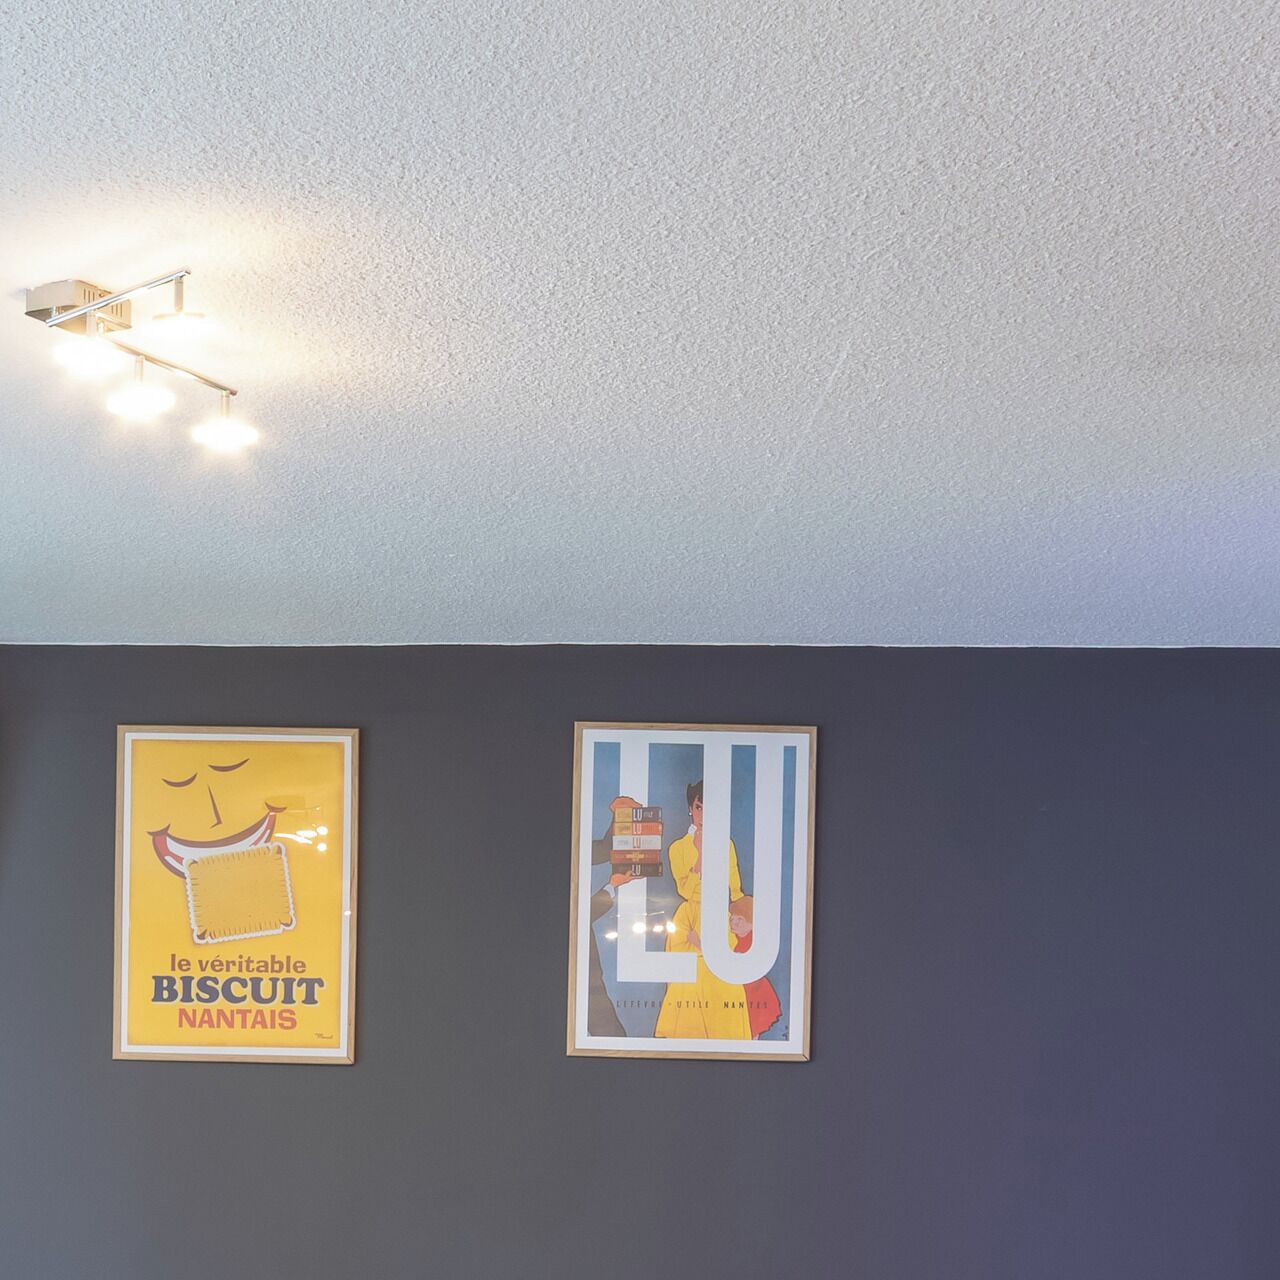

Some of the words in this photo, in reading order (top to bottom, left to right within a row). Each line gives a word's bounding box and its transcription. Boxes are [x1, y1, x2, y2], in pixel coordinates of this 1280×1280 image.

[616, 742, 785, 984] LU
[169, 953, 192, 973] le
[198, 953, 307, 975] véritable
[151, 975, 324, 1004] BISCUIT
[177, 1008, 297, 1031] NANTAIS
